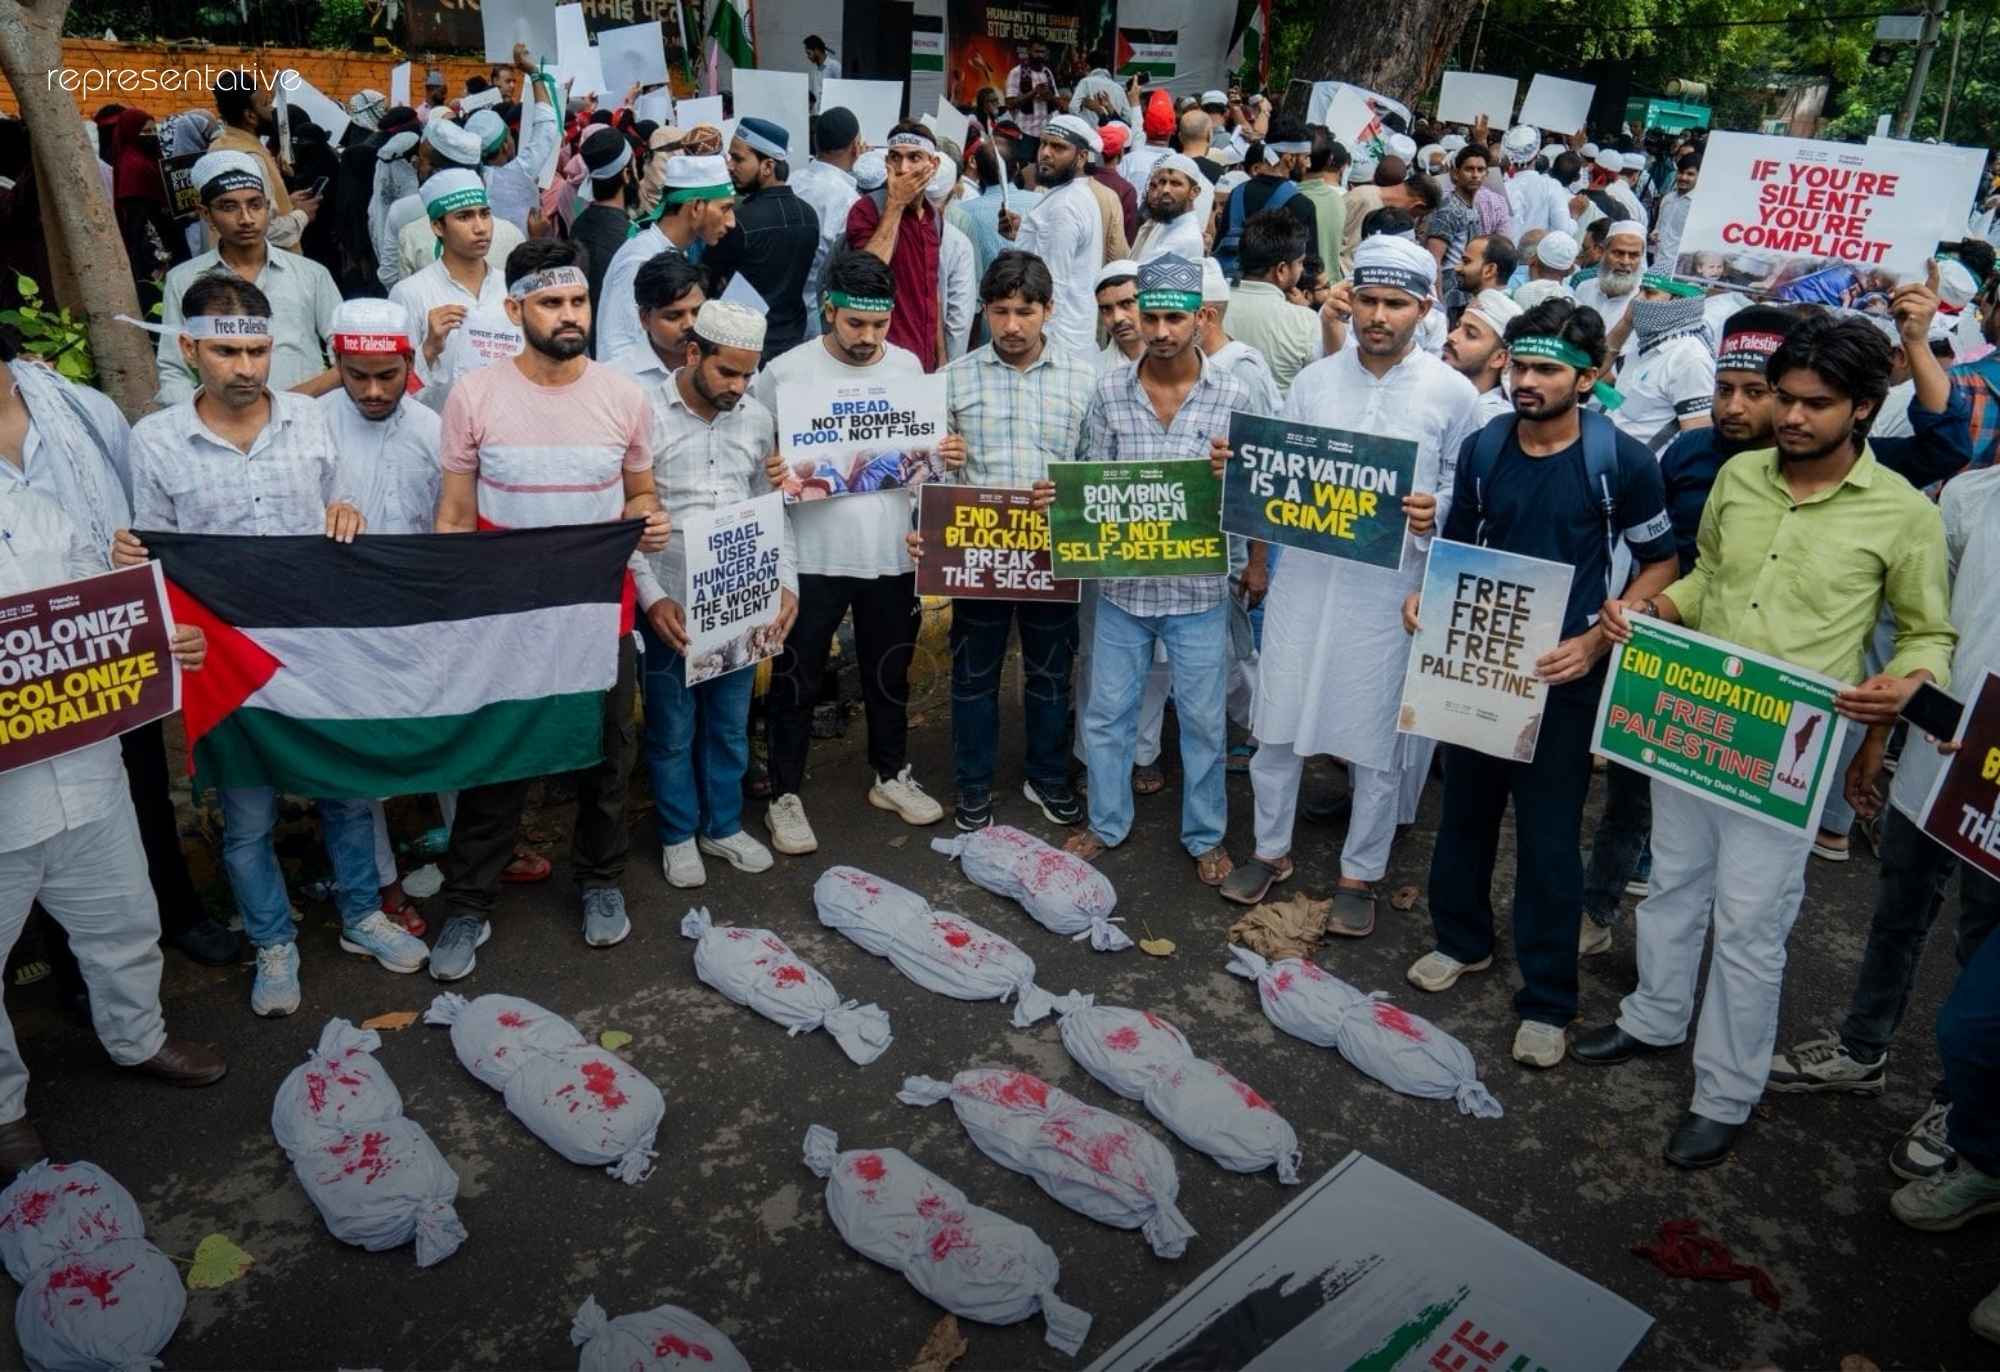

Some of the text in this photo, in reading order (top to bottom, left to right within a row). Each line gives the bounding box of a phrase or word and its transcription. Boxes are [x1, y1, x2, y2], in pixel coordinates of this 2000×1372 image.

[1750, 160, 1899, 197] IF YOU'RE
[1760, 183, 1873, 217] SILENT,
[1760, 205, 1867, 238] YOU'RE
[1723, 223, 1892, 264] COMPLICIT
[360, 335, 397, 352] Palestine
[811, 411, 916, 431] NOT BOMBS!
[849, 427, 883, 441] NOT
[887, 422, 935, 438] F-16S!
[1240, 443, 1398, 496] STARVATION
[1083, 482, 1185, 505] BOMBING
[1083, 502, 1188, 523] CHILDREN
[1250, 470, 1377, 517] IS A WAR
[708, 520, 764, 551] ISRAEL
[955, 505, 1049, 531] END THE
[1101, 522, 1171, 542] IS NOT
[1265, 499, 1359, 540] CRIME
[693, 547, 780, 590] HUNGER AS
[717, 540, 757, 564] USES
[964, 548, 1038, 570] BREAK
[1057, 538, 1221, 562] SELF-DEFENSE
[695, 563, 777, 604] A WEAPON
[942, 566, 1055, 591] THE SIEGE
[1456, 572, 1536, 614] FREE
[691, 578, 780, 620] THE WORLD
[701, 594, 772, 633] IS SILENT
[1451, 600, 1530, 642] FREE
[1446, 628, 1523, 670] FREE
[1420, 653, 1539, 699] PALESTINE
[1622, 646, 1792, 727] END OCCUPATION
[1654, 691, 1737, 742] FREE
[1608, 704, 1775, 788] PALESTINE
[1656, 756, 1762, 804] Welfare Party Delhi State
